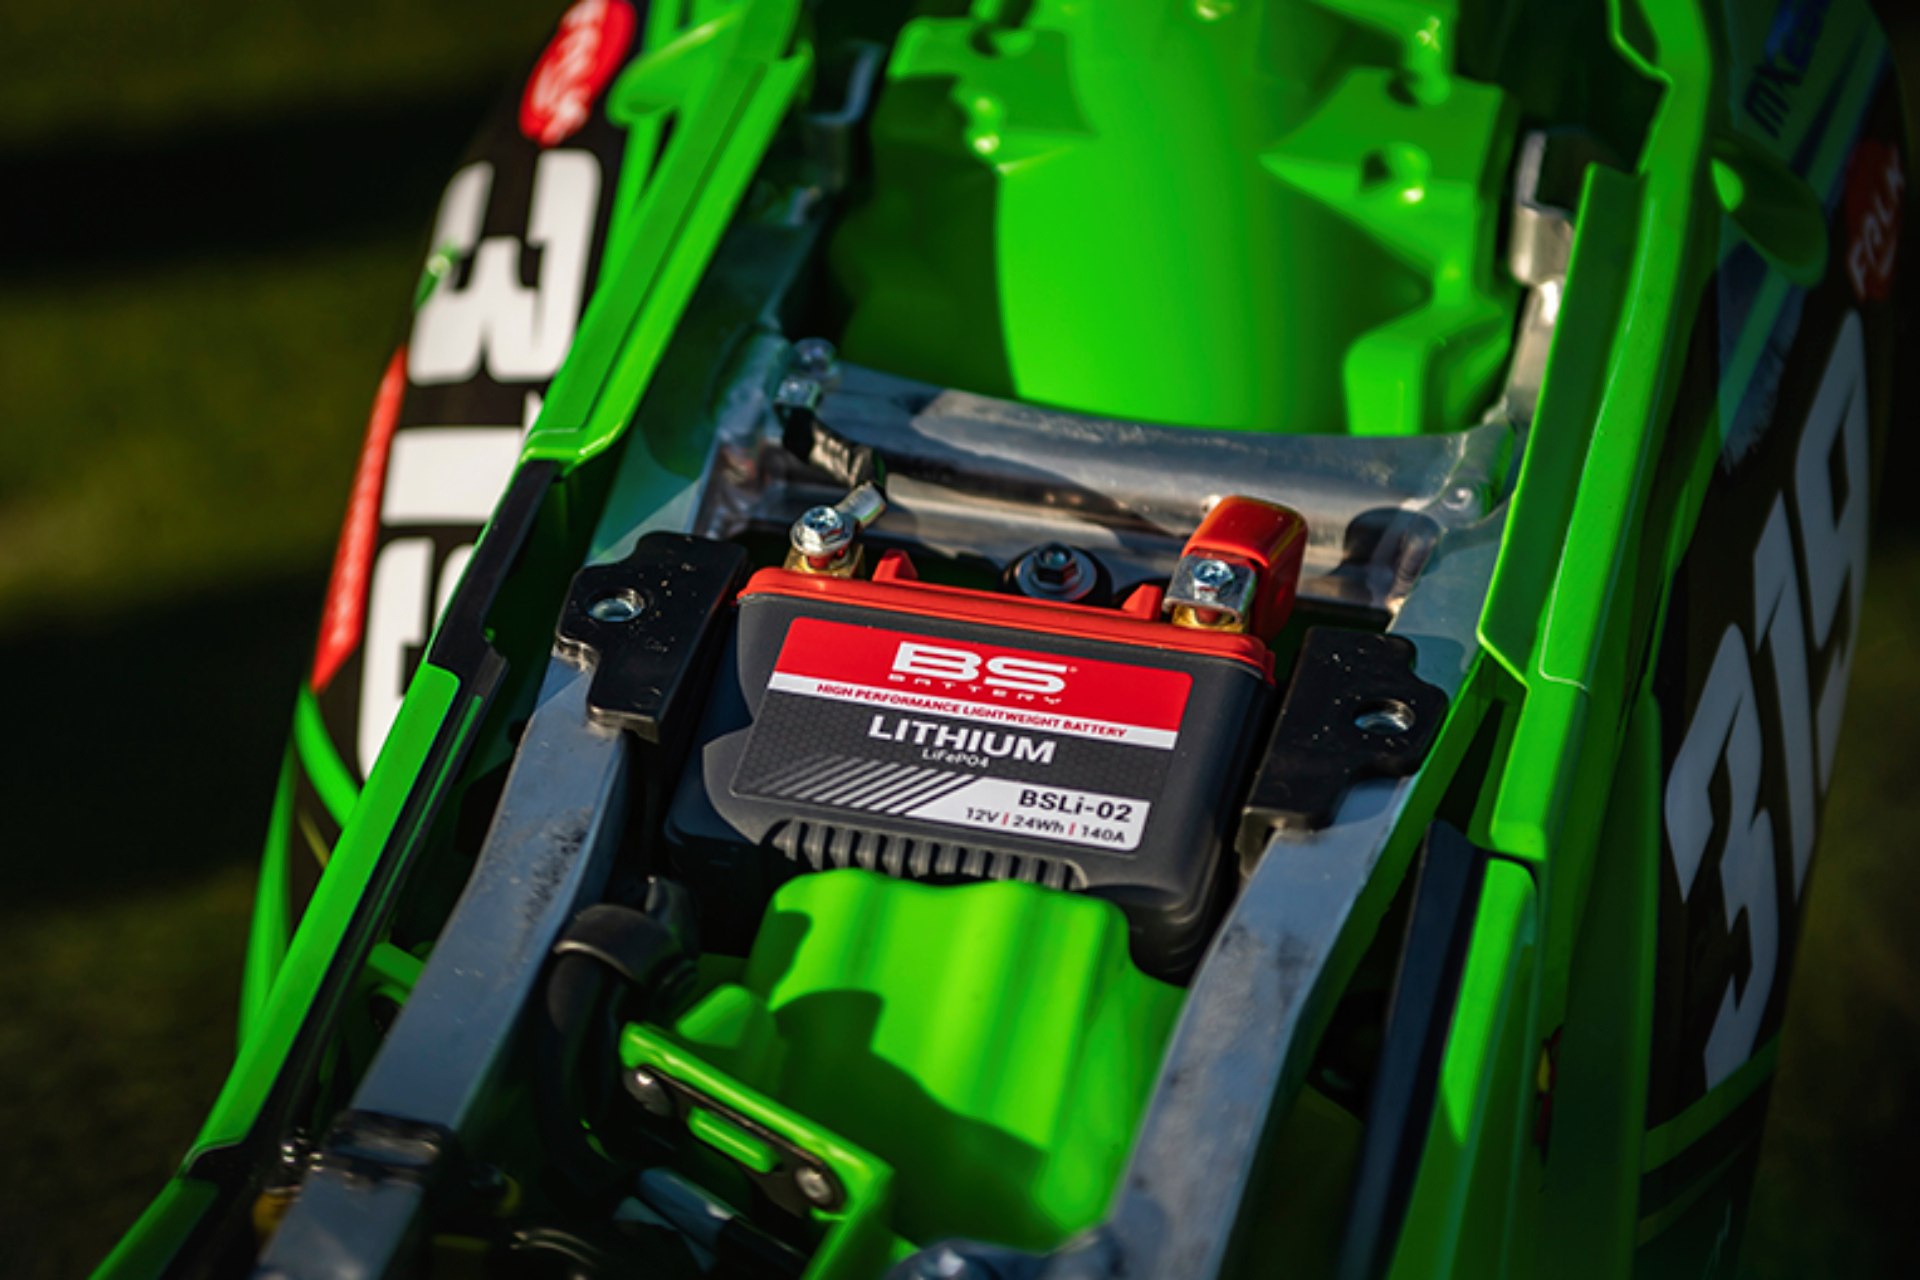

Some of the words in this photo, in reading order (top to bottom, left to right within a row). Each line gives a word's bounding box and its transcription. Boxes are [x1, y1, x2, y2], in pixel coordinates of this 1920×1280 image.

[816, 683, 853, 697] HIGH
[854, 689, 961, 714] PERFORMANCE
[962, 704, 1060, 728] LIGHTWEIGHT
[1062, 719, 1128, 738] BATTERY
[1665, 308, 1869, 1093] 319
[868, 714, 1058, 765] LITHIUM
[921, 748, 990, 768] LiFePO4
[965, 806, 1001, 823] 12V
[1012, 814, 1065, 834] 24Wh
[1080, 824, 1126, 844] 140A
[1018, 788, 1133, 823] BSLi-02
